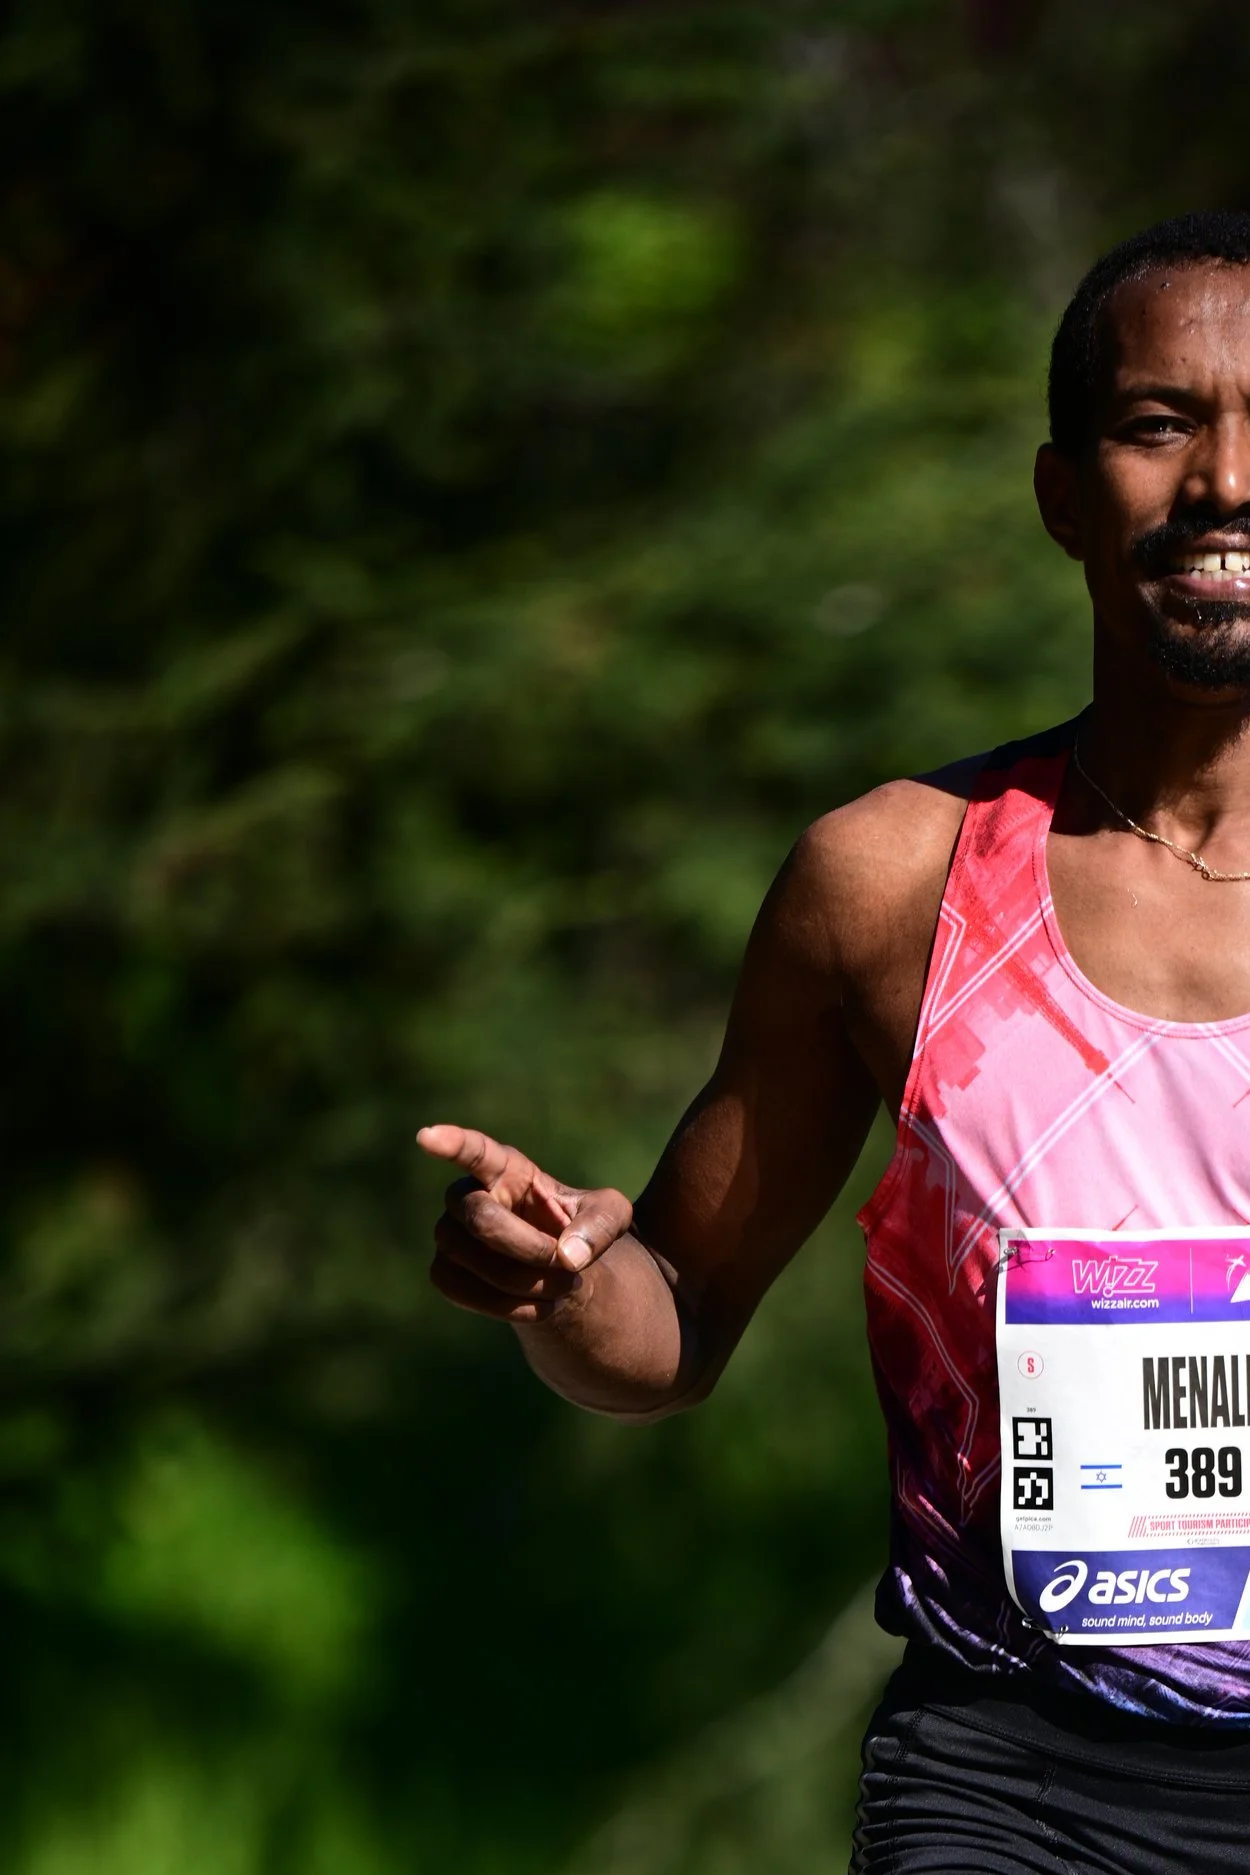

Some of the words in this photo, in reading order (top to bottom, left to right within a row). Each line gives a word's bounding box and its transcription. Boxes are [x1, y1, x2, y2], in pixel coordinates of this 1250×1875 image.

[1091, 1297, 1160, 1310] wizzair.com
[1027, 1357, 1035, 1374] S
[1165, 1446, 1243, 1499] 389
[1150, 1519, 1175, 1531] SPORT
[1178, 1519, 1214, 1530] TOURISM
[1081, 1615, 1117, 1628] sound
[1117, 1614, 1147, 1628] mind,
[1149, 1612, 1184, 1626] sound
[1184, 1611, 1213, 1627] body
